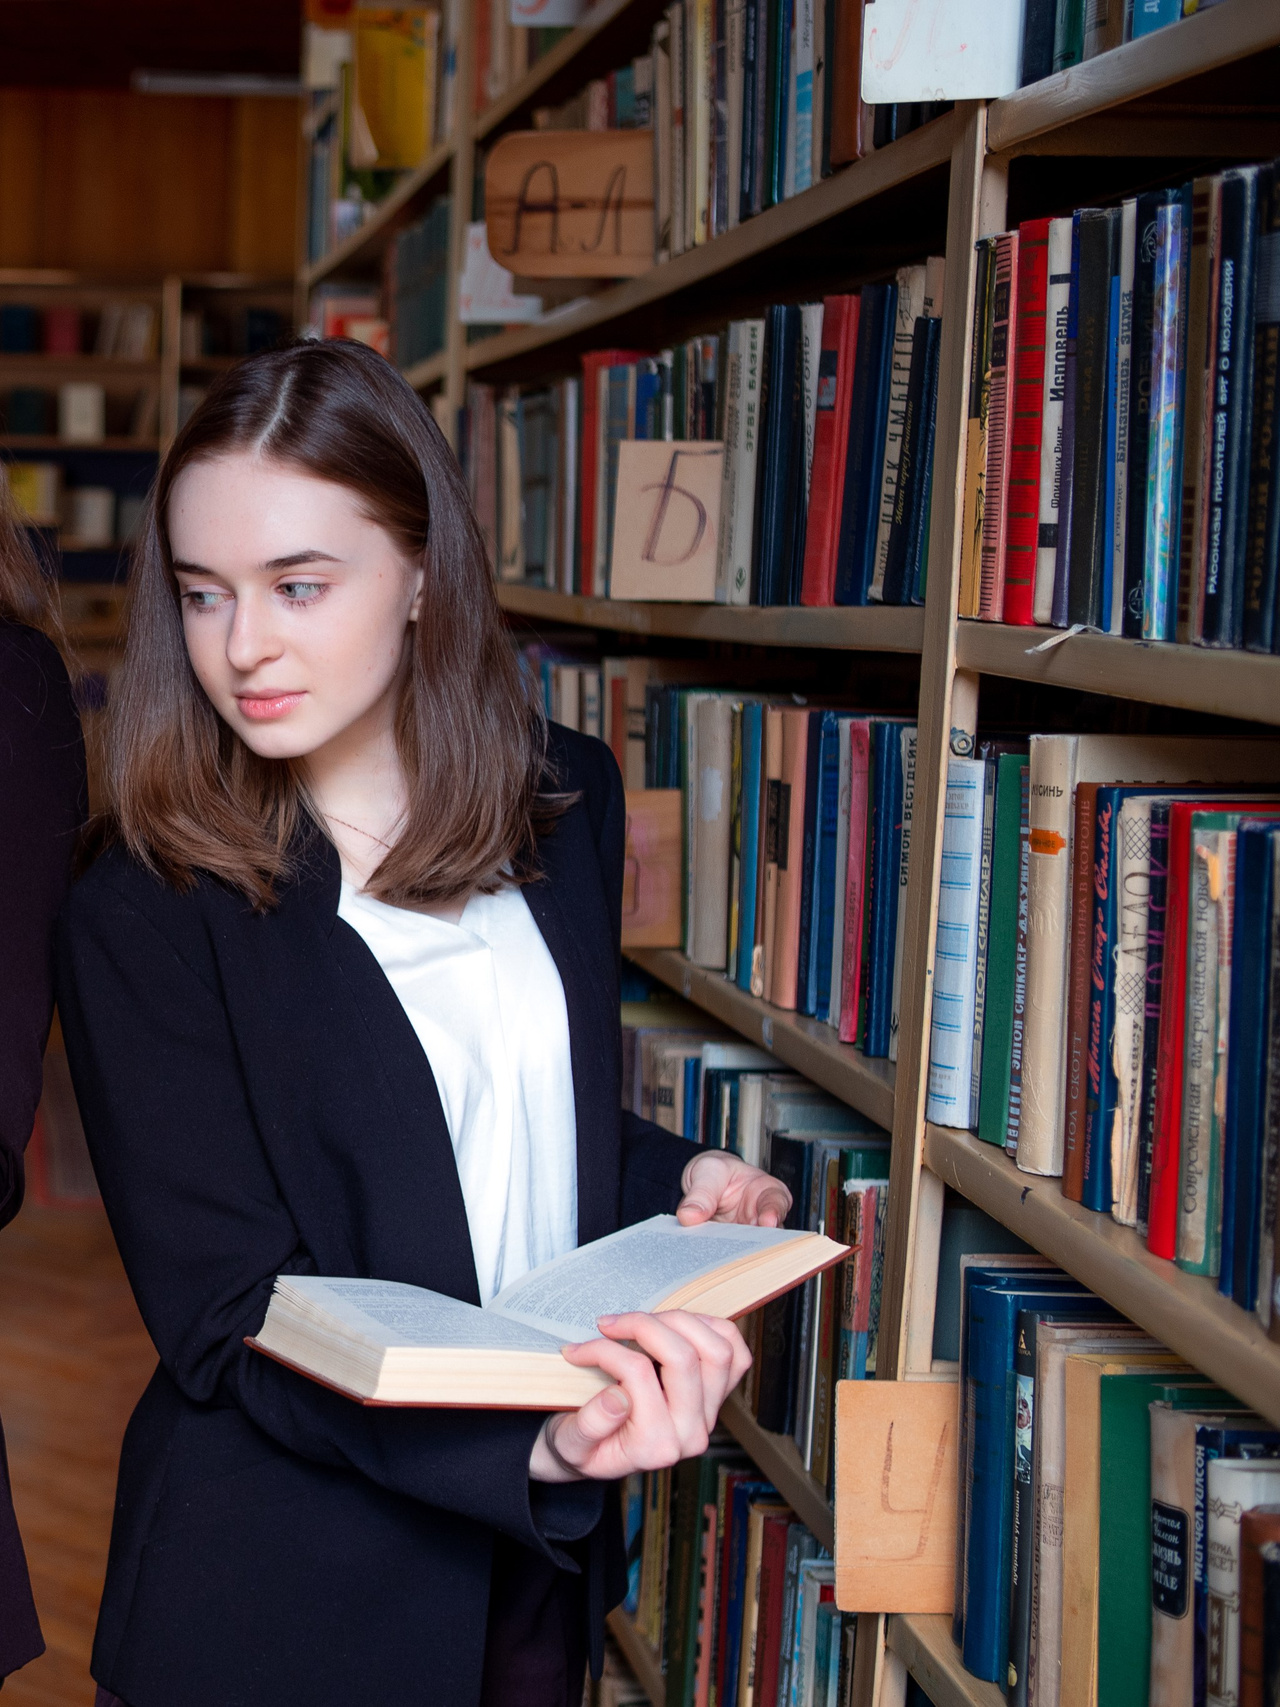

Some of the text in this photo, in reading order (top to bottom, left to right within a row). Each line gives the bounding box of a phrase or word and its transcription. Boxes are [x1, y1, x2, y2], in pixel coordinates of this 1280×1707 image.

[746, 326, 757, 453] ЭРВЕ БАЗЕН
[1207, 259, 1235, 595] РАССКАЗЫ ПИСАТЕЛЕЙ ФРГ О МОЛОДЕЖИ
[900, 736, 917, 887] СИМОН ВЕСТДЕЙК
[1079, 799, 1092, 878] КОРОНЕ
[974, 852, 991, 1036] ЭПТОН СИНКЛЕР
[1013, 942, 1027, 1014] СИНКЛЕР
[1073, 896, 1090, 1025] ЖЕМЧУЖИНА
[1187, 929, 1209, 1070] американская
[1012, 1020, 1024, 1070] ЭПТОН
[1070, 1030, 1083, 1100] СКОТТ
[1067, 1106, 1079, 1152] ПОЛ
[1181, 1082, 1202, 1214] Современная
[1194, 1444, 1205, 1582] Митчел Уилсон
